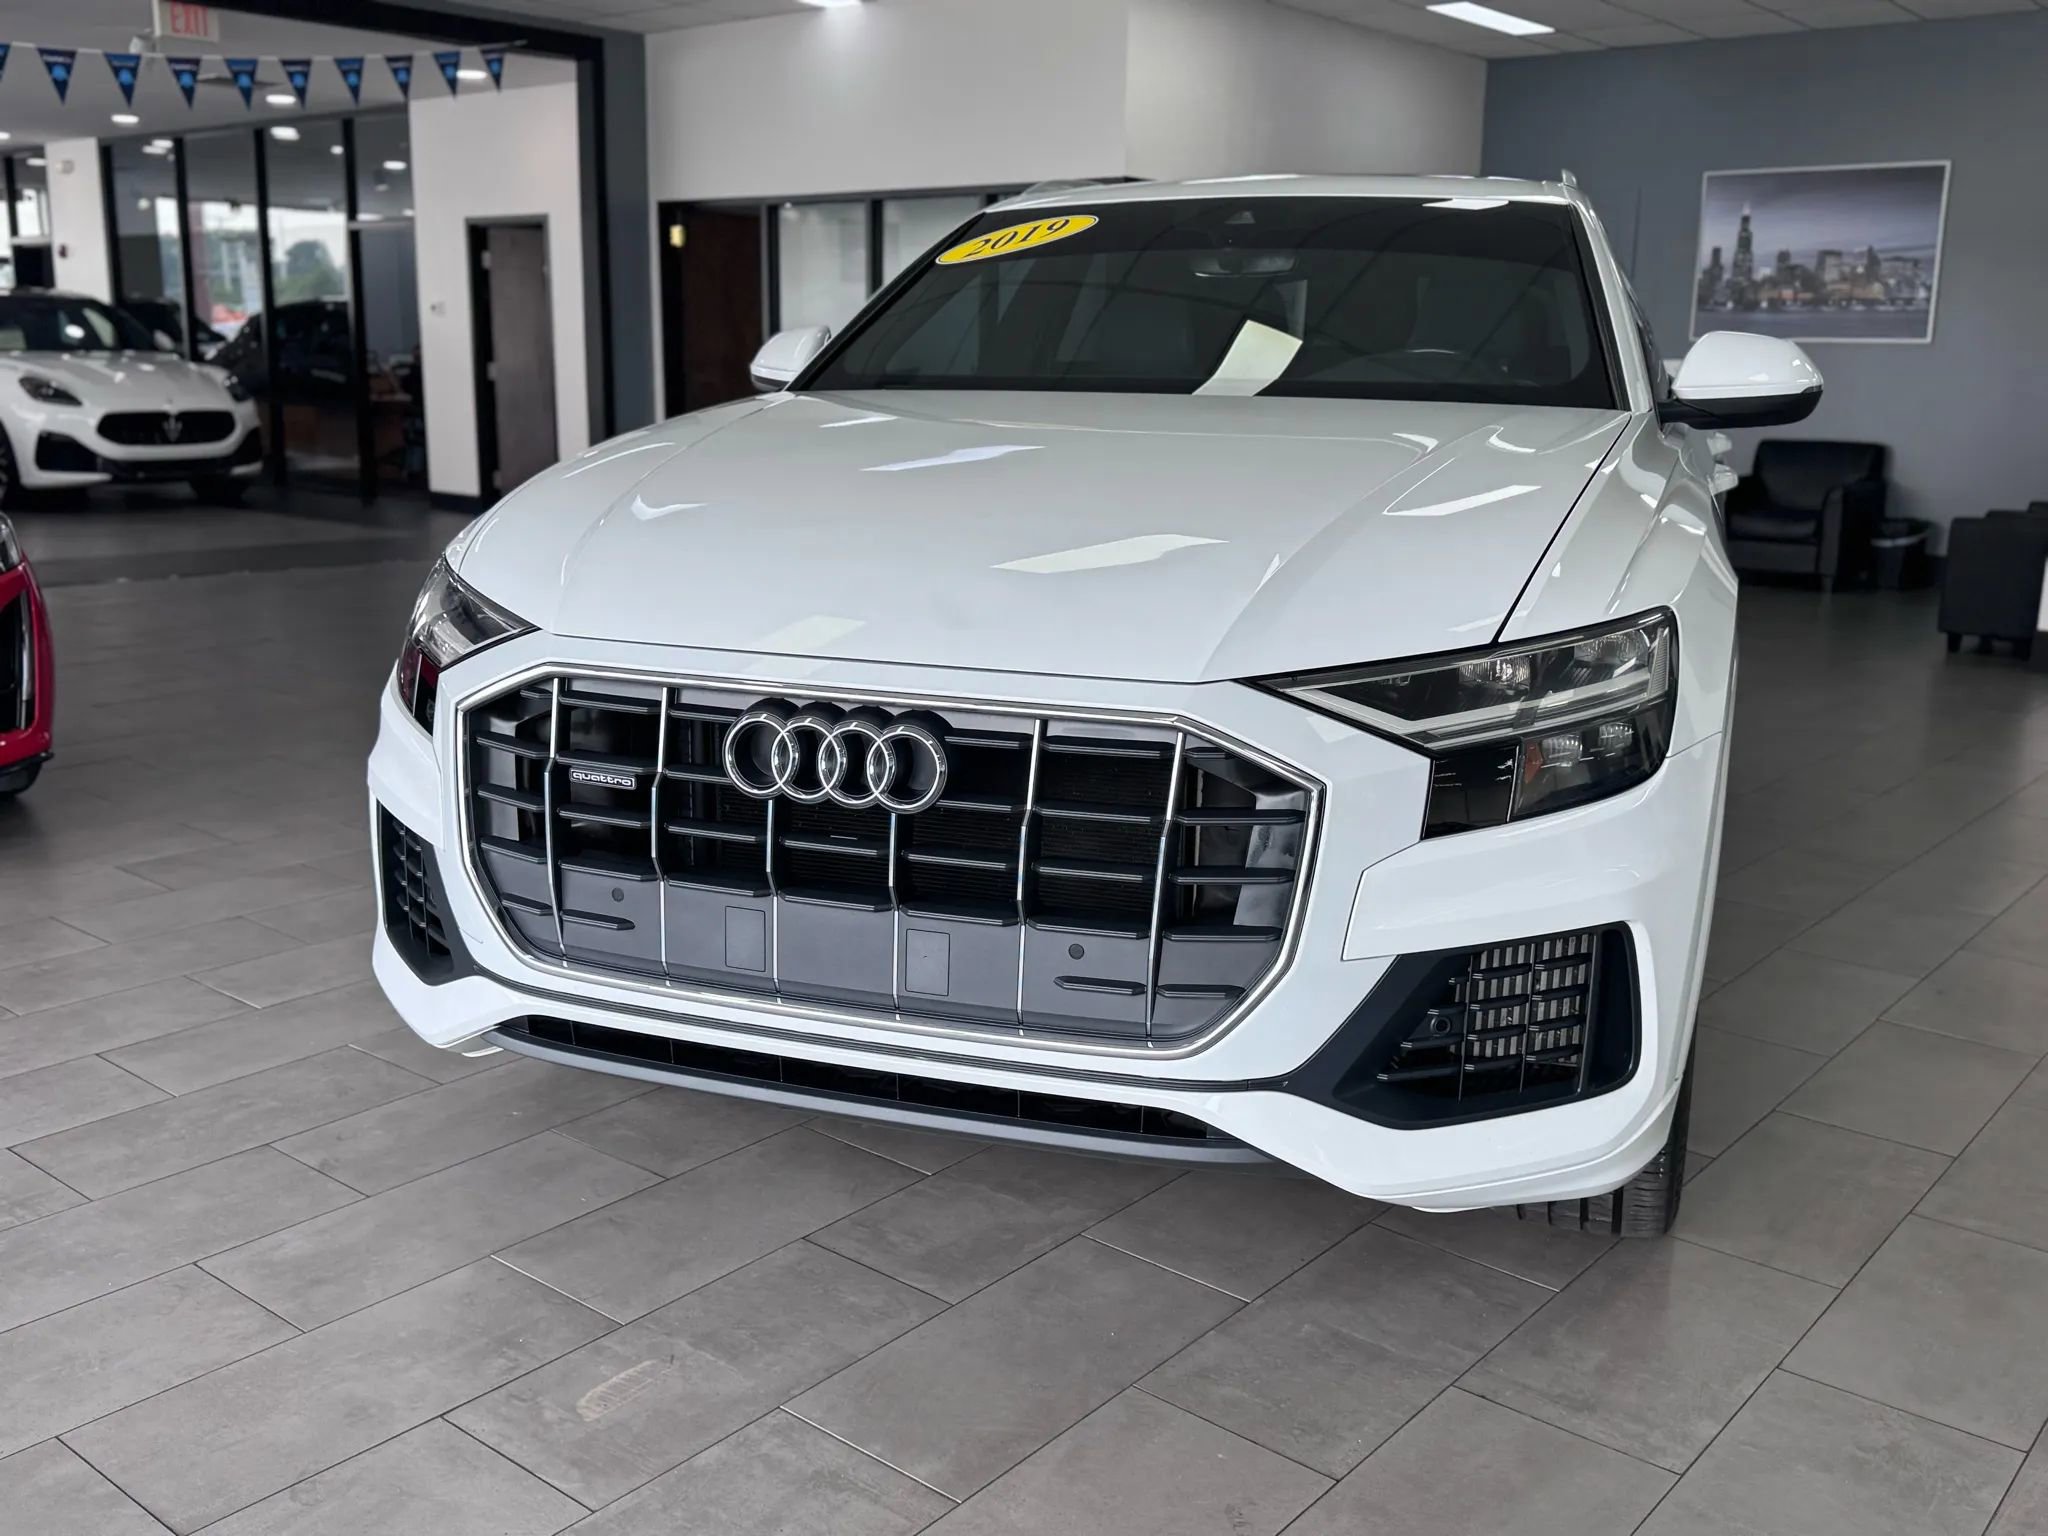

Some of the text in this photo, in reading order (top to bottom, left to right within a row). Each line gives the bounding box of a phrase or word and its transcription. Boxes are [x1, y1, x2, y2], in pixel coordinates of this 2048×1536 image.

[170, 1, 208, 37] EXIT
[962, 219, 1071, 258] 2019
[572, 772, 632, 786] quattro
